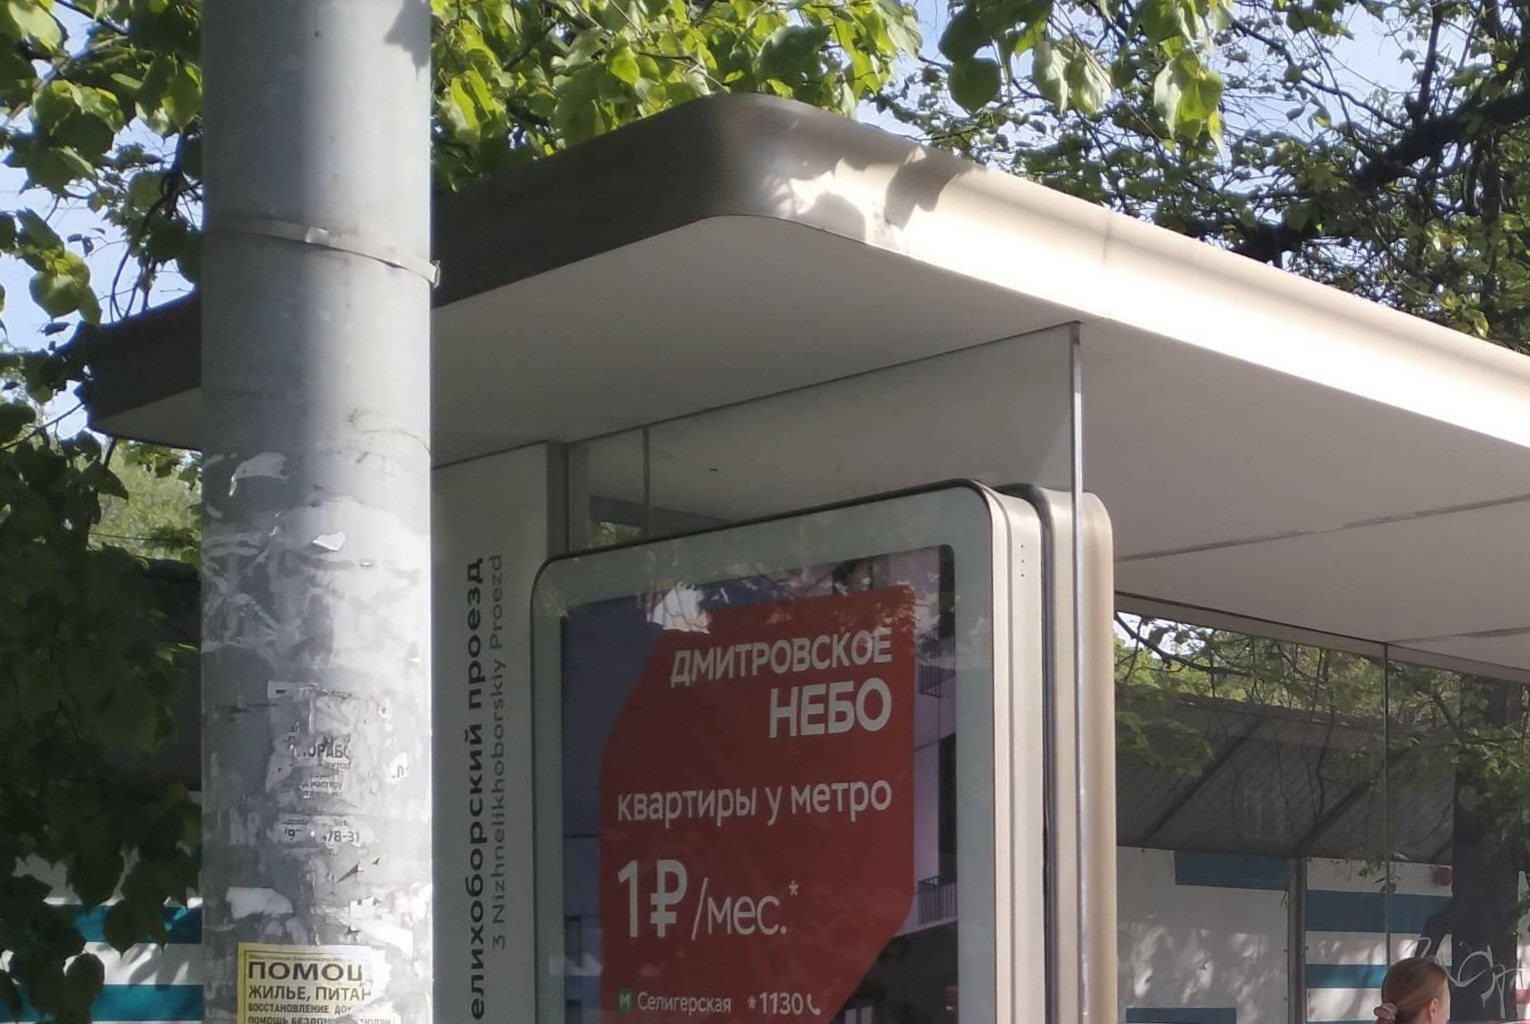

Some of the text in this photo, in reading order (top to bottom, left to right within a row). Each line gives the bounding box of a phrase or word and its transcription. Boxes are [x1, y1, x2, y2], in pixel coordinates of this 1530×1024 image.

[466, 557, 486, 710] проезд
[670, 627, 893, 689] ДМИТРОВСКОЕ
[768, 677, 893, 739] НЕБО
[487, 554, 507, 950] 3 Nizhnelikhoborskiy Proezd
[617, 779, 893, 829] квартиры у метро
[248, 985, 312, 1003] ЖИЛЬЕ,
[248, 1003, 330, 1014] ВОССТАНОВЛЕНИЕ
[636, 990, 733, 1016] Селигерская
